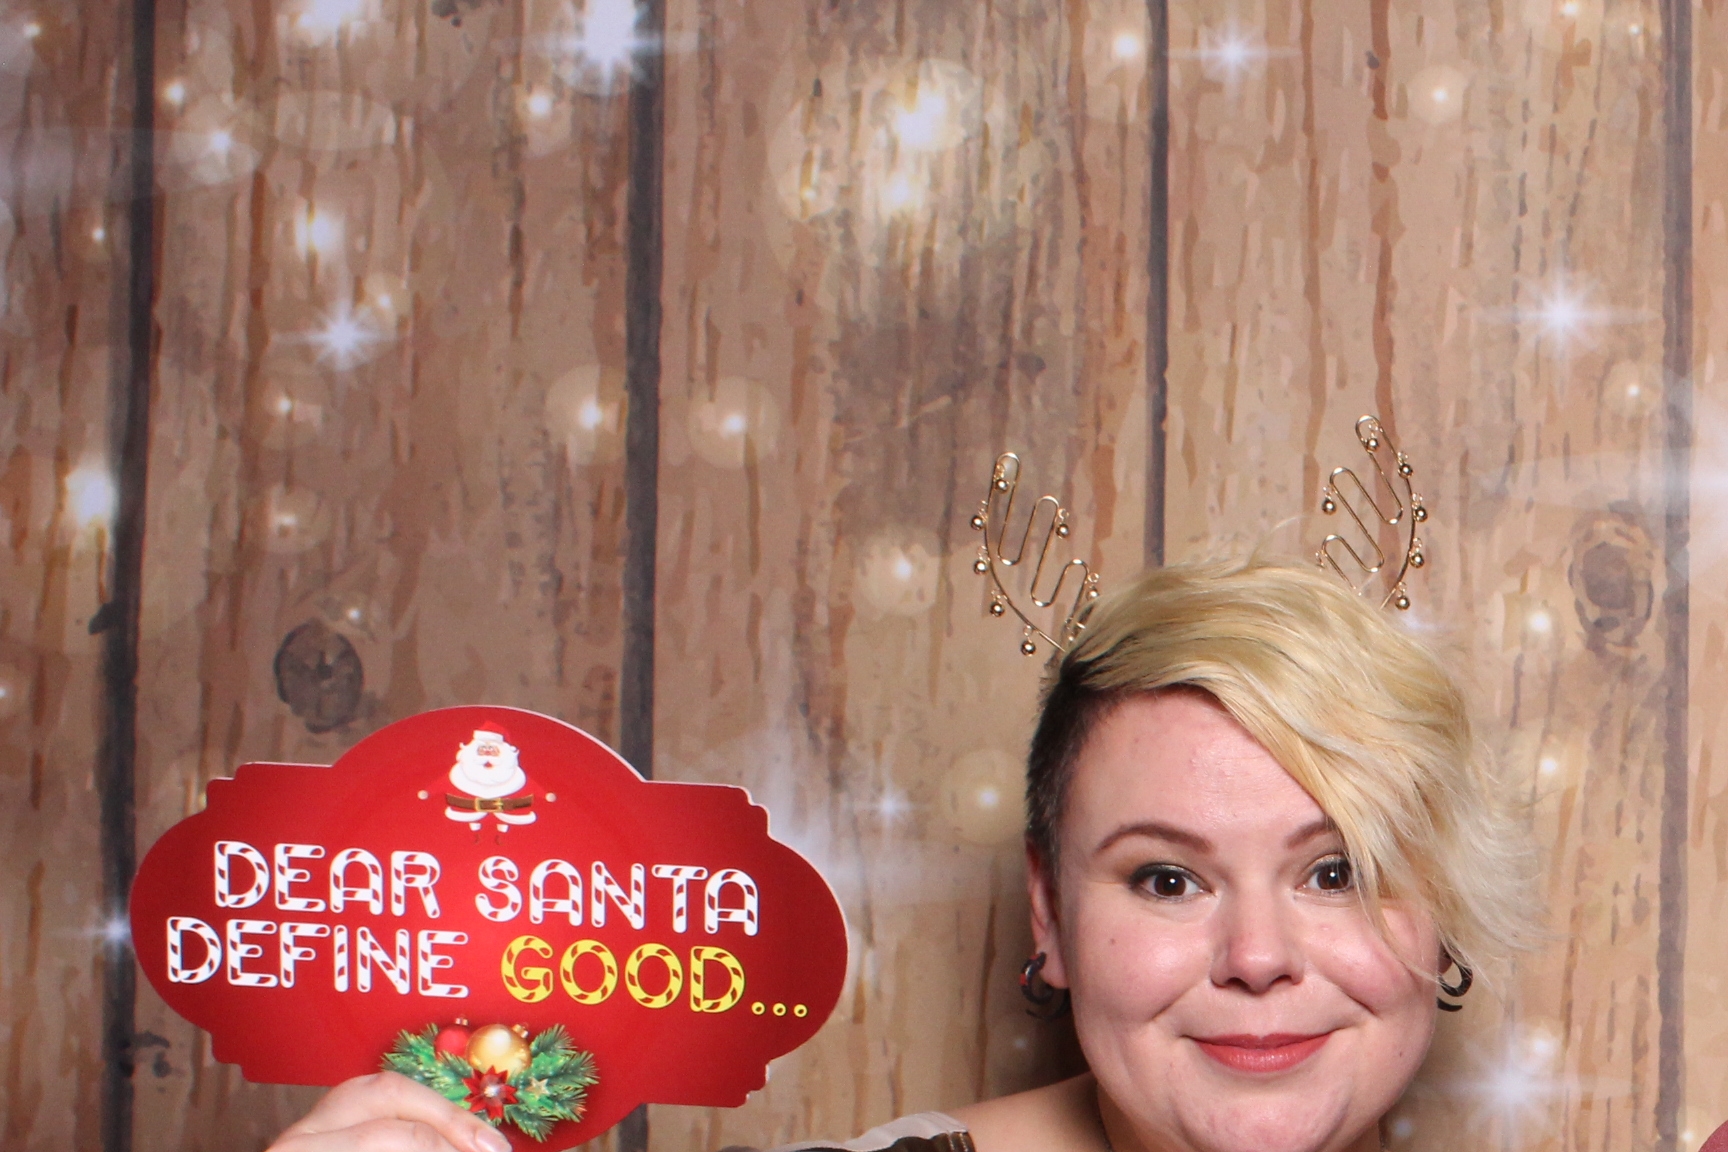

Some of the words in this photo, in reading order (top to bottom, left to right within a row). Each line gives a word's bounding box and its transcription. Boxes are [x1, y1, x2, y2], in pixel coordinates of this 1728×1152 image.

[213, 840, 442, 919] DEAR
[474, 855, 760, 937] SANTA
[166, 916, 470, 999] DEFINE
[500, 934, 808, 1018] GOOD...
